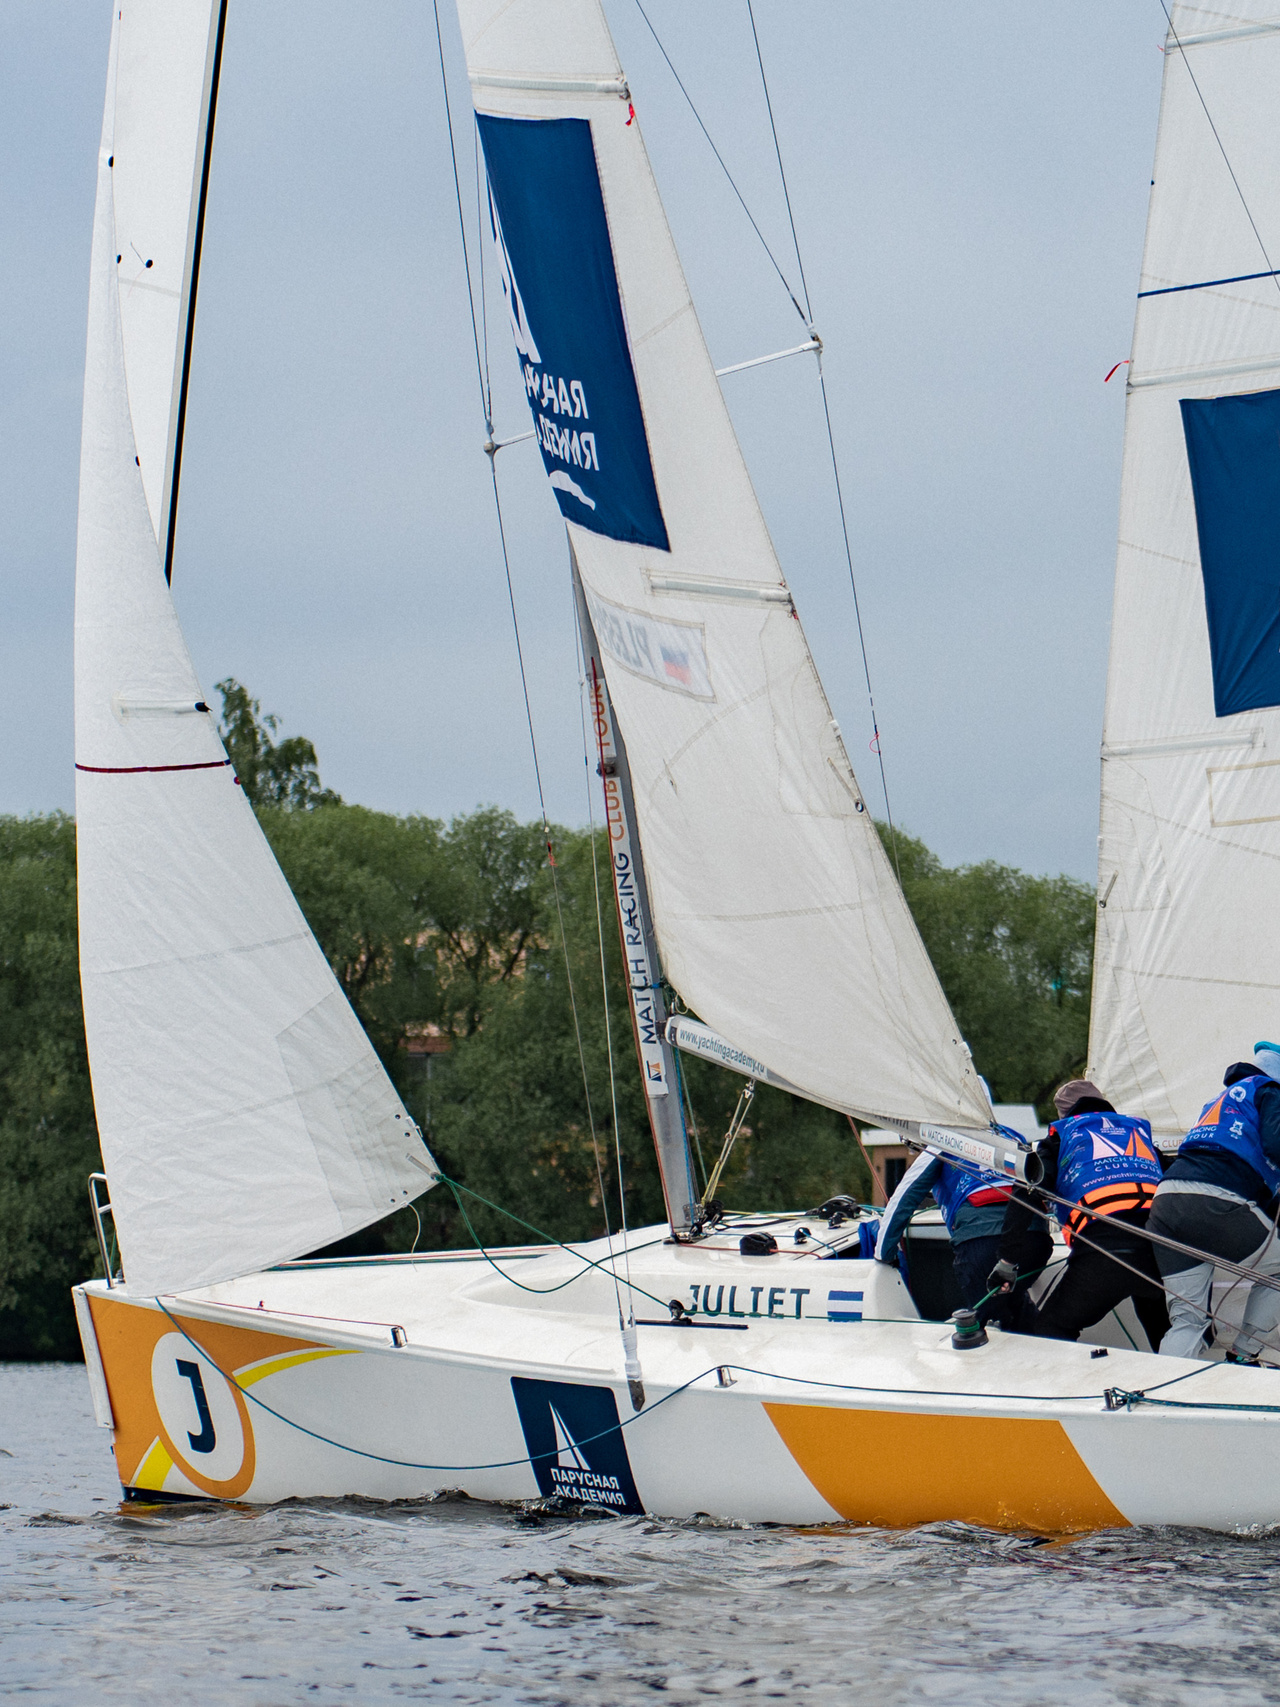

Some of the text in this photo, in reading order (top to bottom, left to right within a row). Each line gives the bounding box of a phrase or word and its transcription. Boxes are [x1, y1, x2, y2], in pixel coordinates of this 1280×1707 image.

[589, 683, 658, 1045] MATCH RACING CLUB TOUR
[680, 1028, 765, 1074] www.yachtingacademy.ru
[927, 1129, 992, 1162] MATCH RACING CLUB TOUR
[1094, 1157, 1127, 1166] MATCH
[1094, 1162, 1128, 1172] CLUB
[684, 1284, 811, 1319] JULIET
[175, 1358, 216, 1454] J
[550, 1467, 620, 1490] ПАРУСНАЯ
[554, 1484, 627, 1506] АКАДЕМИЯ
